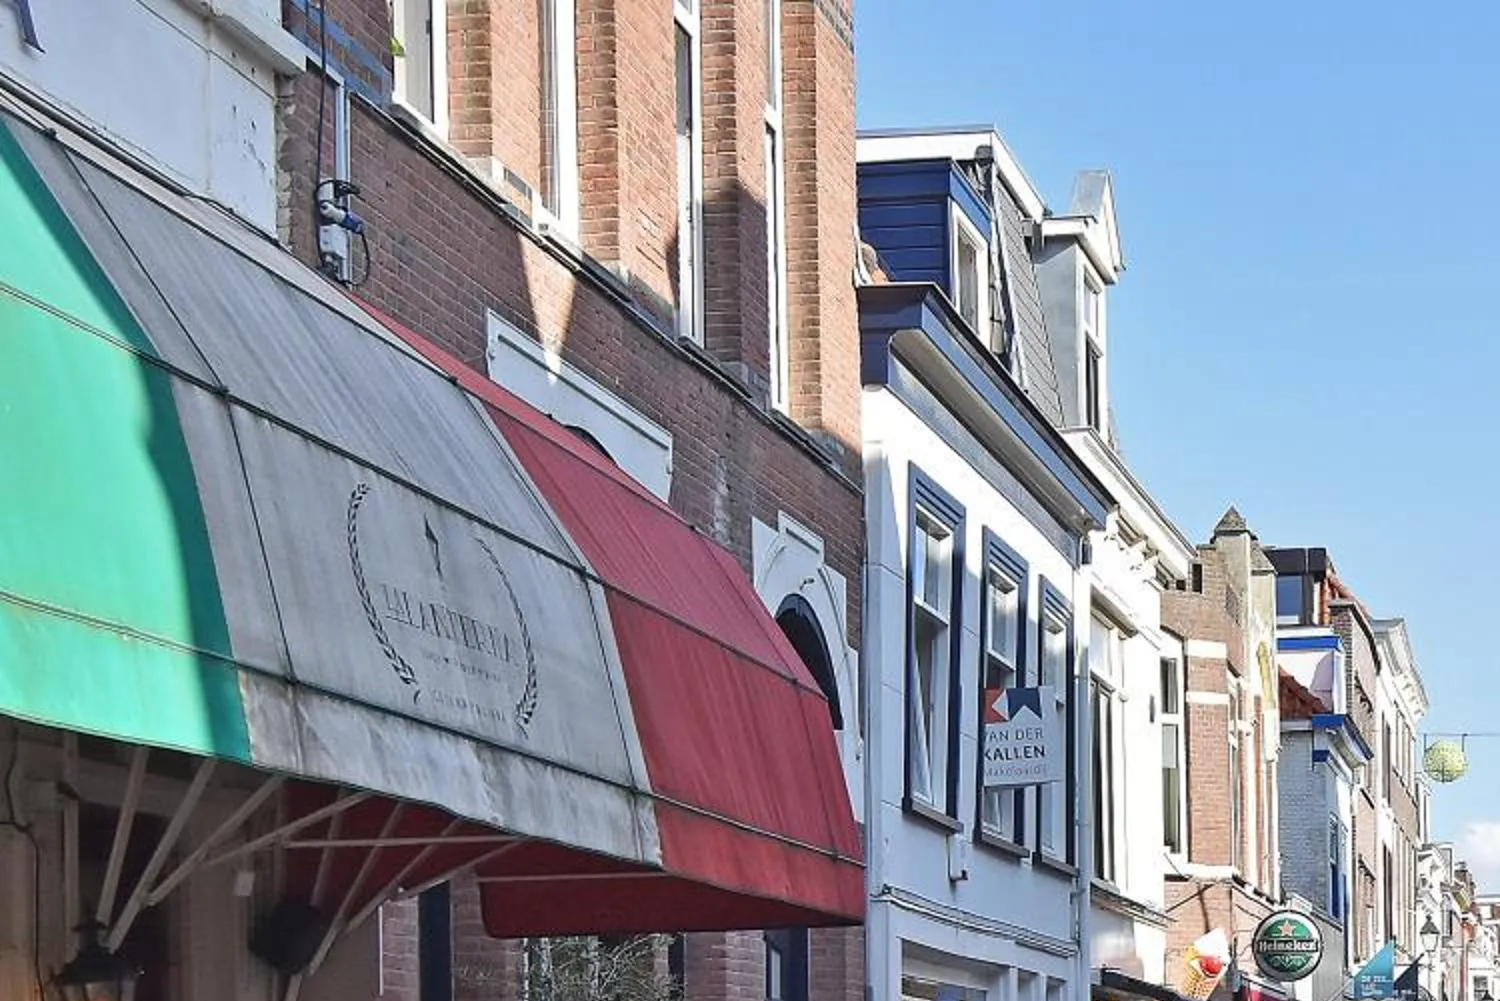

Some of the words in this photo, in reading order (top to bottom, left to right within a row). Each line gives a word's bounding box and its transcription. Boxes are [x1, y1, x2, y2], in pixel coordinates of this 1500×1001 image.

[984, 729, 1010, 742] AN
[1015, 728, 1044, 740] DER
[1259, 939, 1318, 952] Heineken
